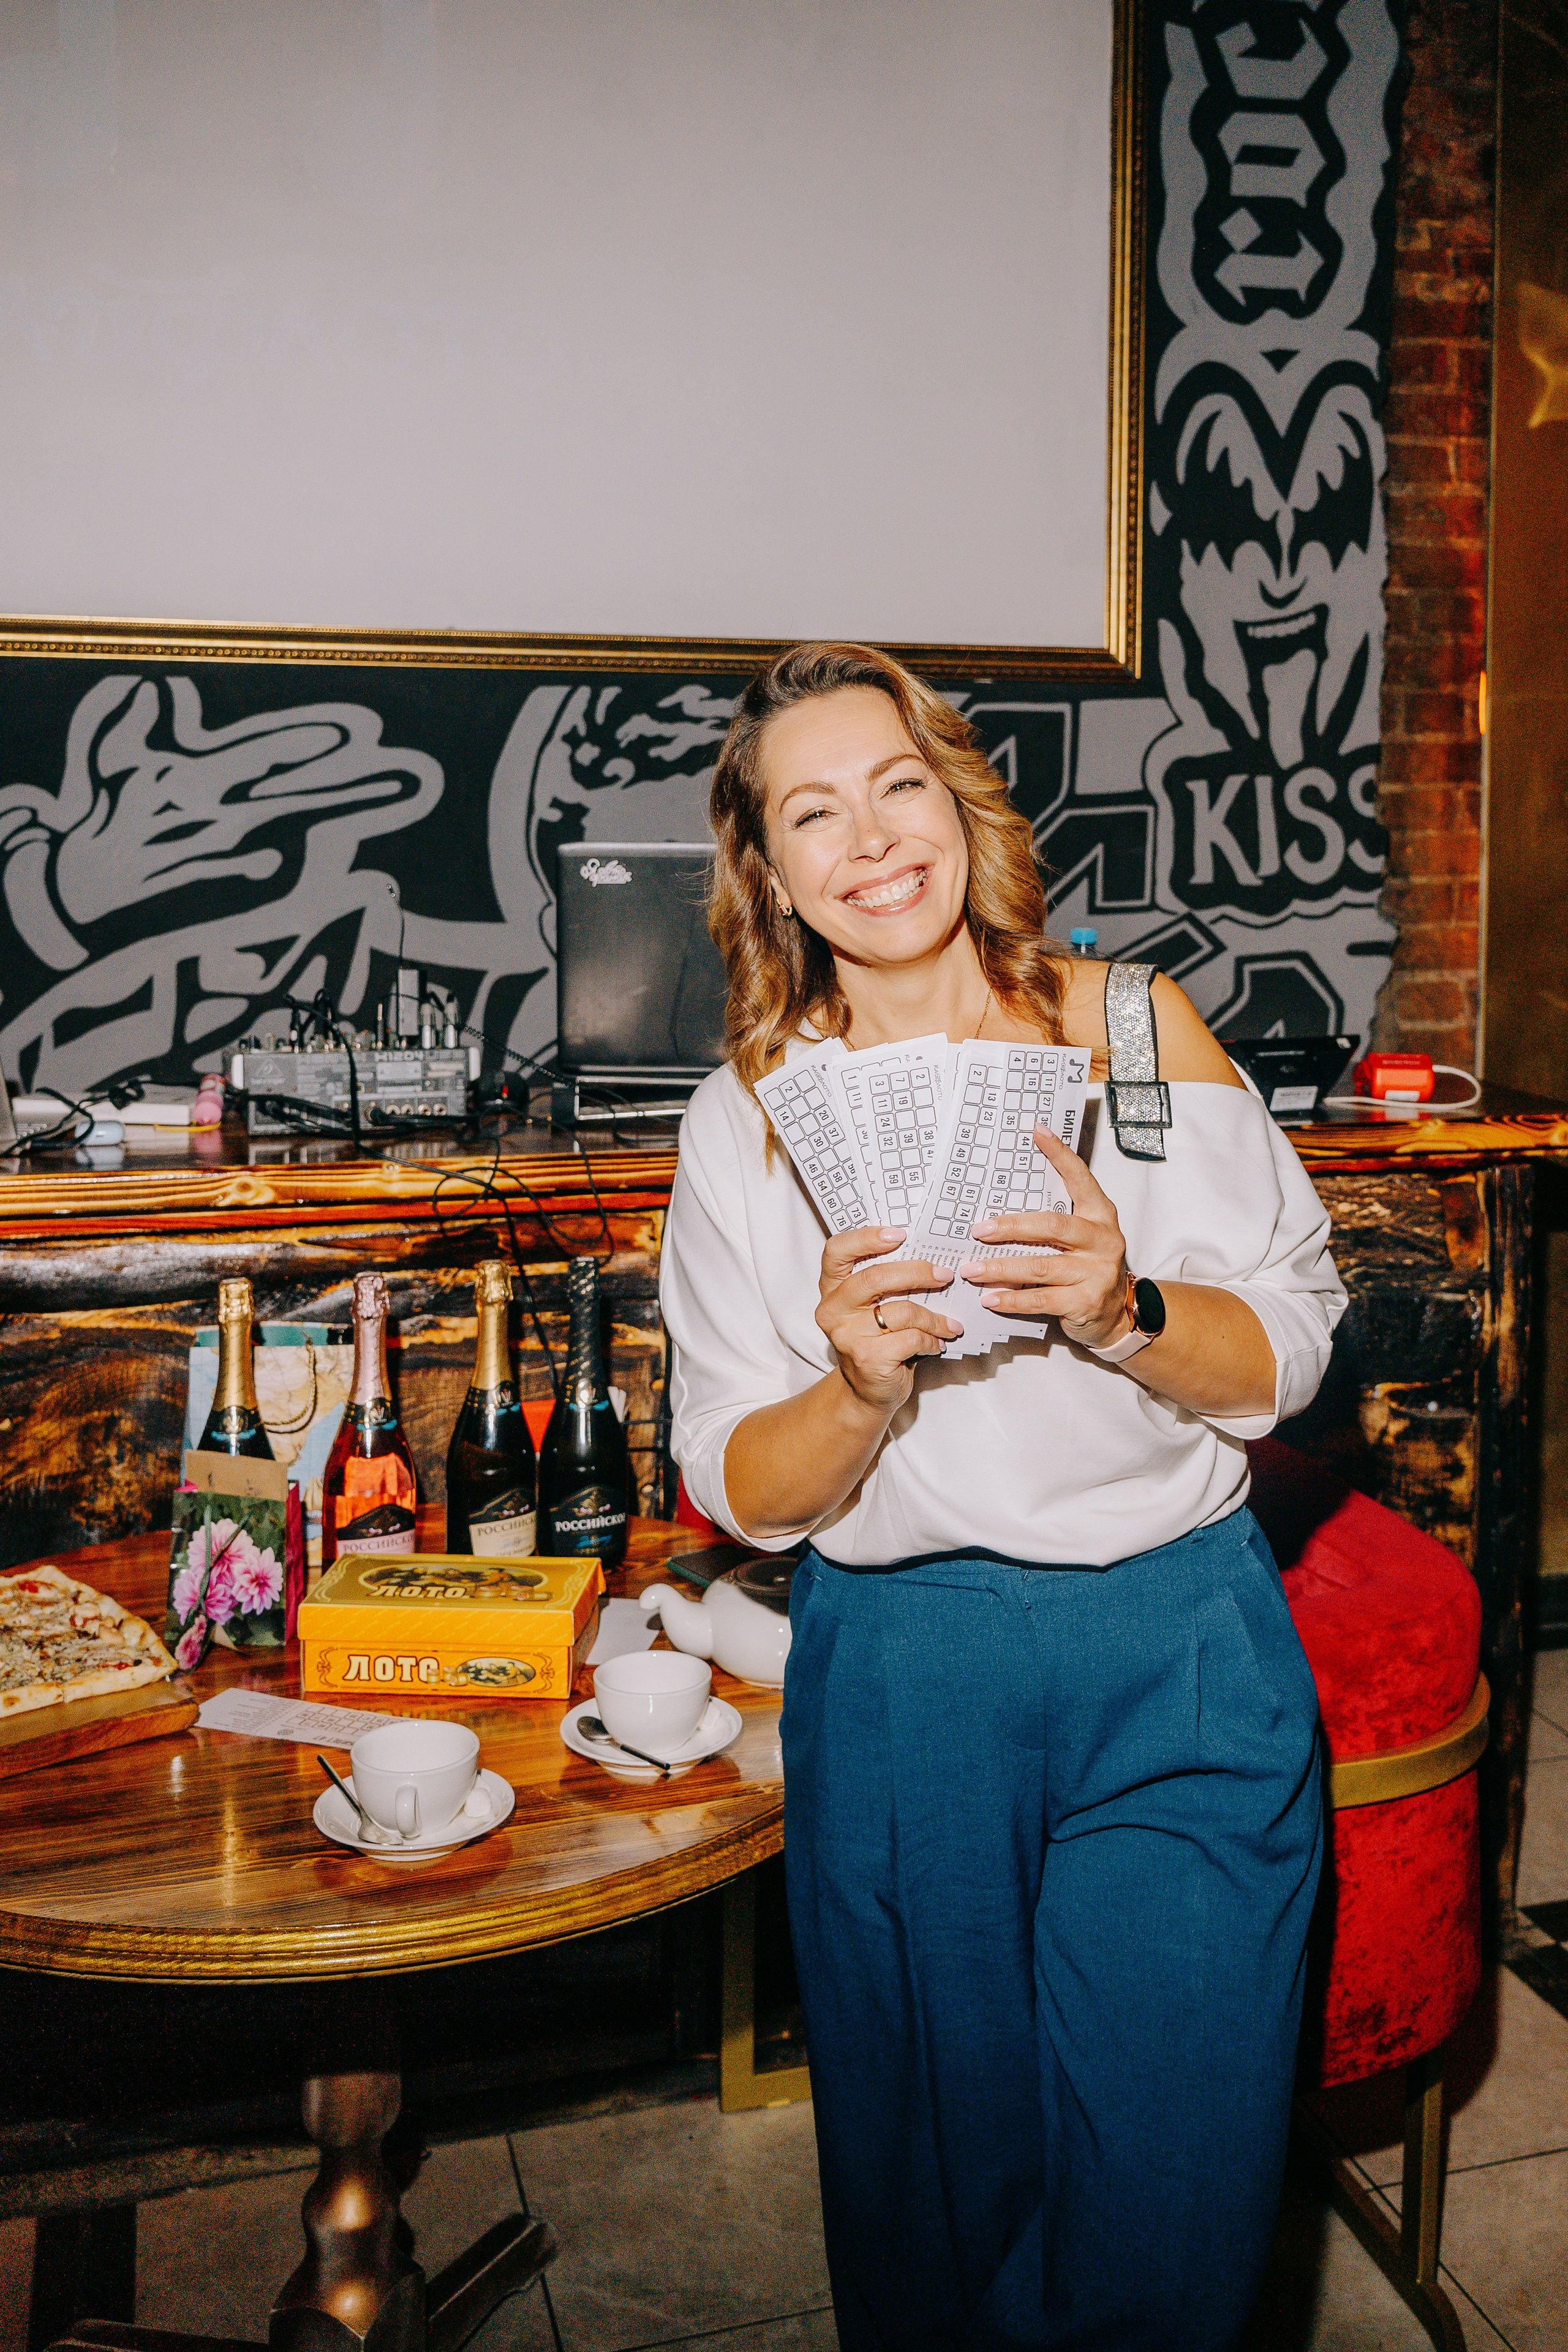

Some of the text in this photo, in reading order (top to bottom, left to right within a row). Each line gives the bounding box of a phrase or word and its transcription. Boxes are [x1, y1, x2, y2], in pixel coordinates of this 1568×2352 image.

[1213, 0, 1330, 307] roc
[1185, 766, 1385, 886] KISS
[1028, 1077, 1036, 1086] 16
[1045, 1078, 1053, 1087] 11
[852, 1092, 862, 1101] 11
[898, 1096, 908, 1105] 19
[987, 1093, 997, 1101] 13
[878, 1099, 888, 1108] 11
[1043, 1097, 1051, 1107] 27
[780, 1111, 790, 1121] 14
[819, 1110, 829, 1121] 20
[984, 1111, 993, 1121] 23
[1006, 1115, 1015, 1125] 35
[881, 1118, 891, 1127] 24
[829, 1128, 840, 1137] 37
[961, 1128, 970, 1139] 39
[1061, 1110, 1076, 1149] БИЛЕТ
[903, 1134, 913, 1143] 39
[924, 1130, 934, 1140] 38
[814, 1136, 824, 1147] 30
[883, 1137, 894, 1147] 32
[1022, 1136, 1030, 1146] 44
[957, 1148, 966, 1158] 49
[1019, 1156, 1028, 1166] 51
[809, 1164, 818, 1174] 46
[951, 1167, 961, 1177] 52
[833, 1172, 843, 1183] 58
[889, 1174, 899, 1184] 59
[909, 1172, 919, 1182] 55
[997, 1175, 1006, 1185] 68
[818, 1180, 827, 1191] 54
[946, 1186, 956, 1196] 67
[965, 1189, 976, 1199] 61
[827, 1198, 837, 1208] 60
[993, 1194, 1003, 1204] 75
[851, 1207, 861, 1218] 73
[960, 1207, 971, 1218] 74
[837, 1215, 846, 1226] 76
[955, 1226, 965, 1235] 90
[477, 1512, 536, 1536] РОССИЙСК
[343, 1532, 415, 1553] РОССИЙСКО
[343, 1654, 439, 1681] ЛОТО
